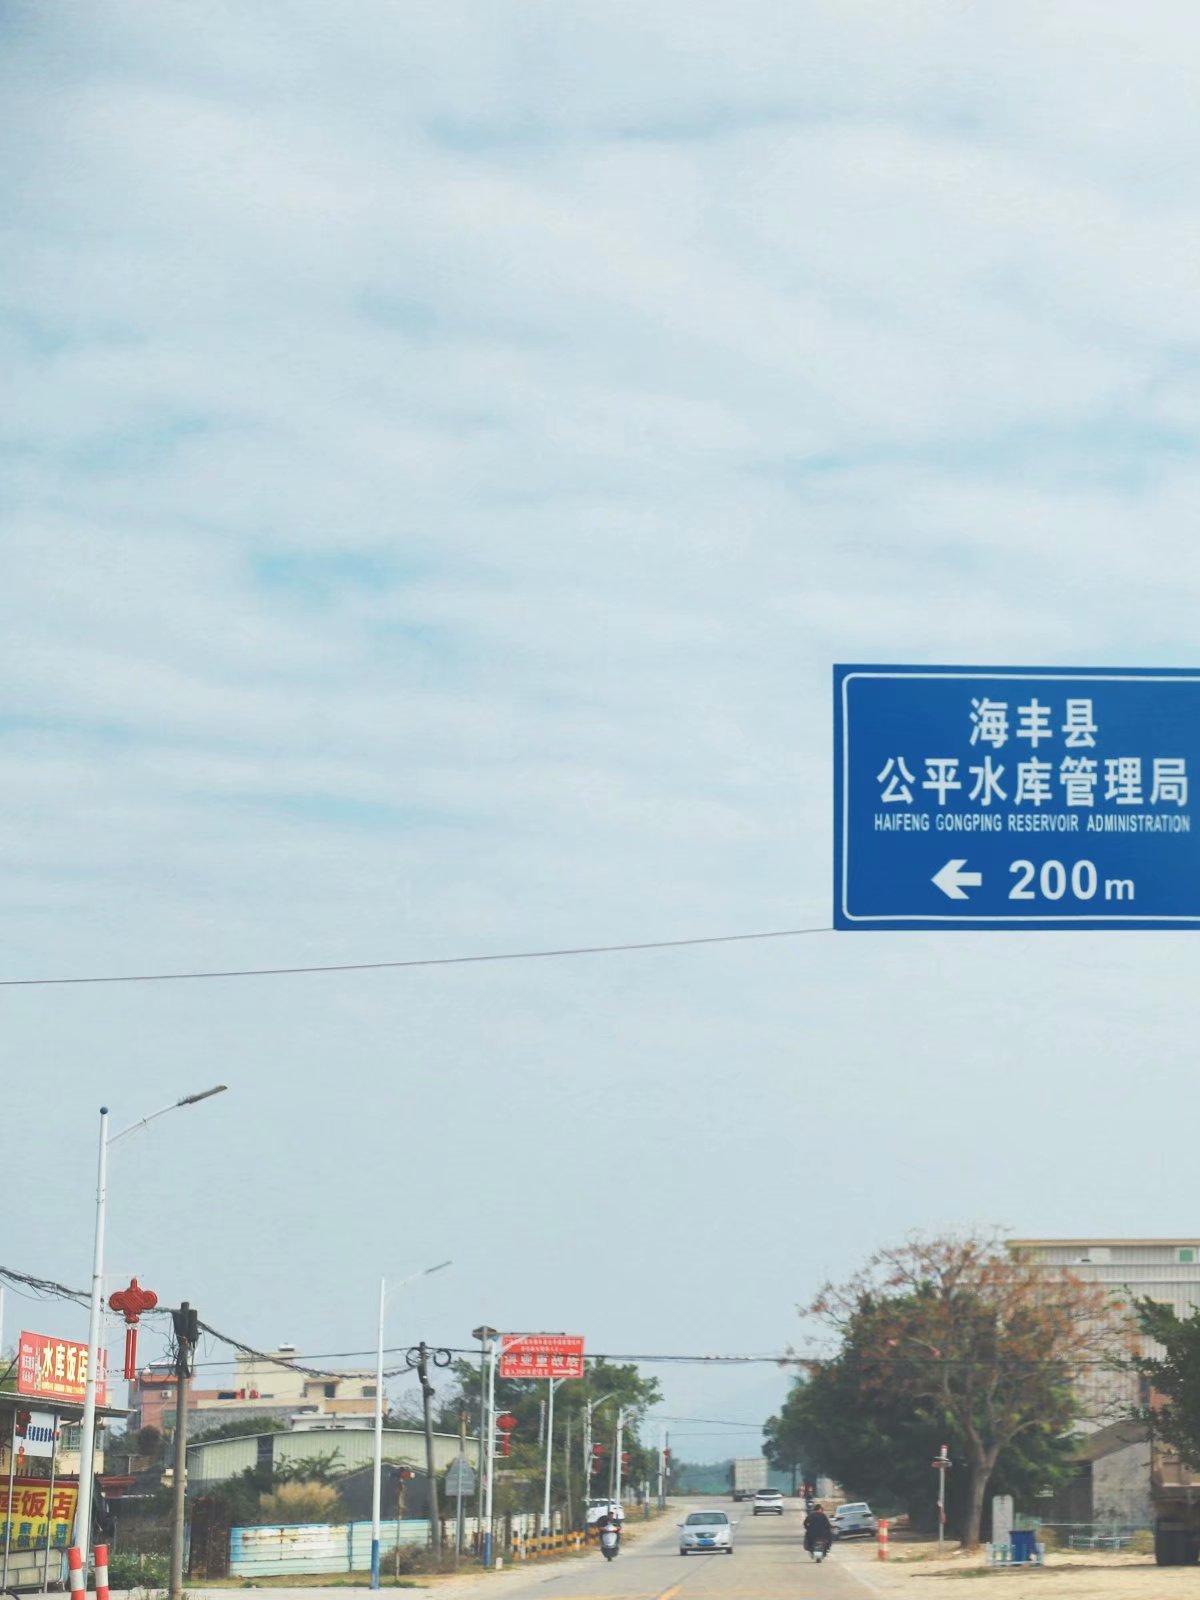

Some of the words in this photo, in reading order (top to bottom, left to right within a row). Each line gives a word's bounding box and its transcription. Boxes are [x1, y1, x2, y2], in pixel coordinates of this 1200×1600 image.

[969, 698, 1098, 748] 海丰县
[876, 756, 1188, 807] 公平水库管理局
[874, 813, 930, 832] HAIFENG
[936, 814, 1002, 832] GONGPING
[1008, 814, 1079, 832] RESERVOIR
[1087, 815, 1191, 832] ADMINISTRATION
[1008, 859, 1135, 901] 200m
[42, 1339, 88, 1387] 水库饭店
